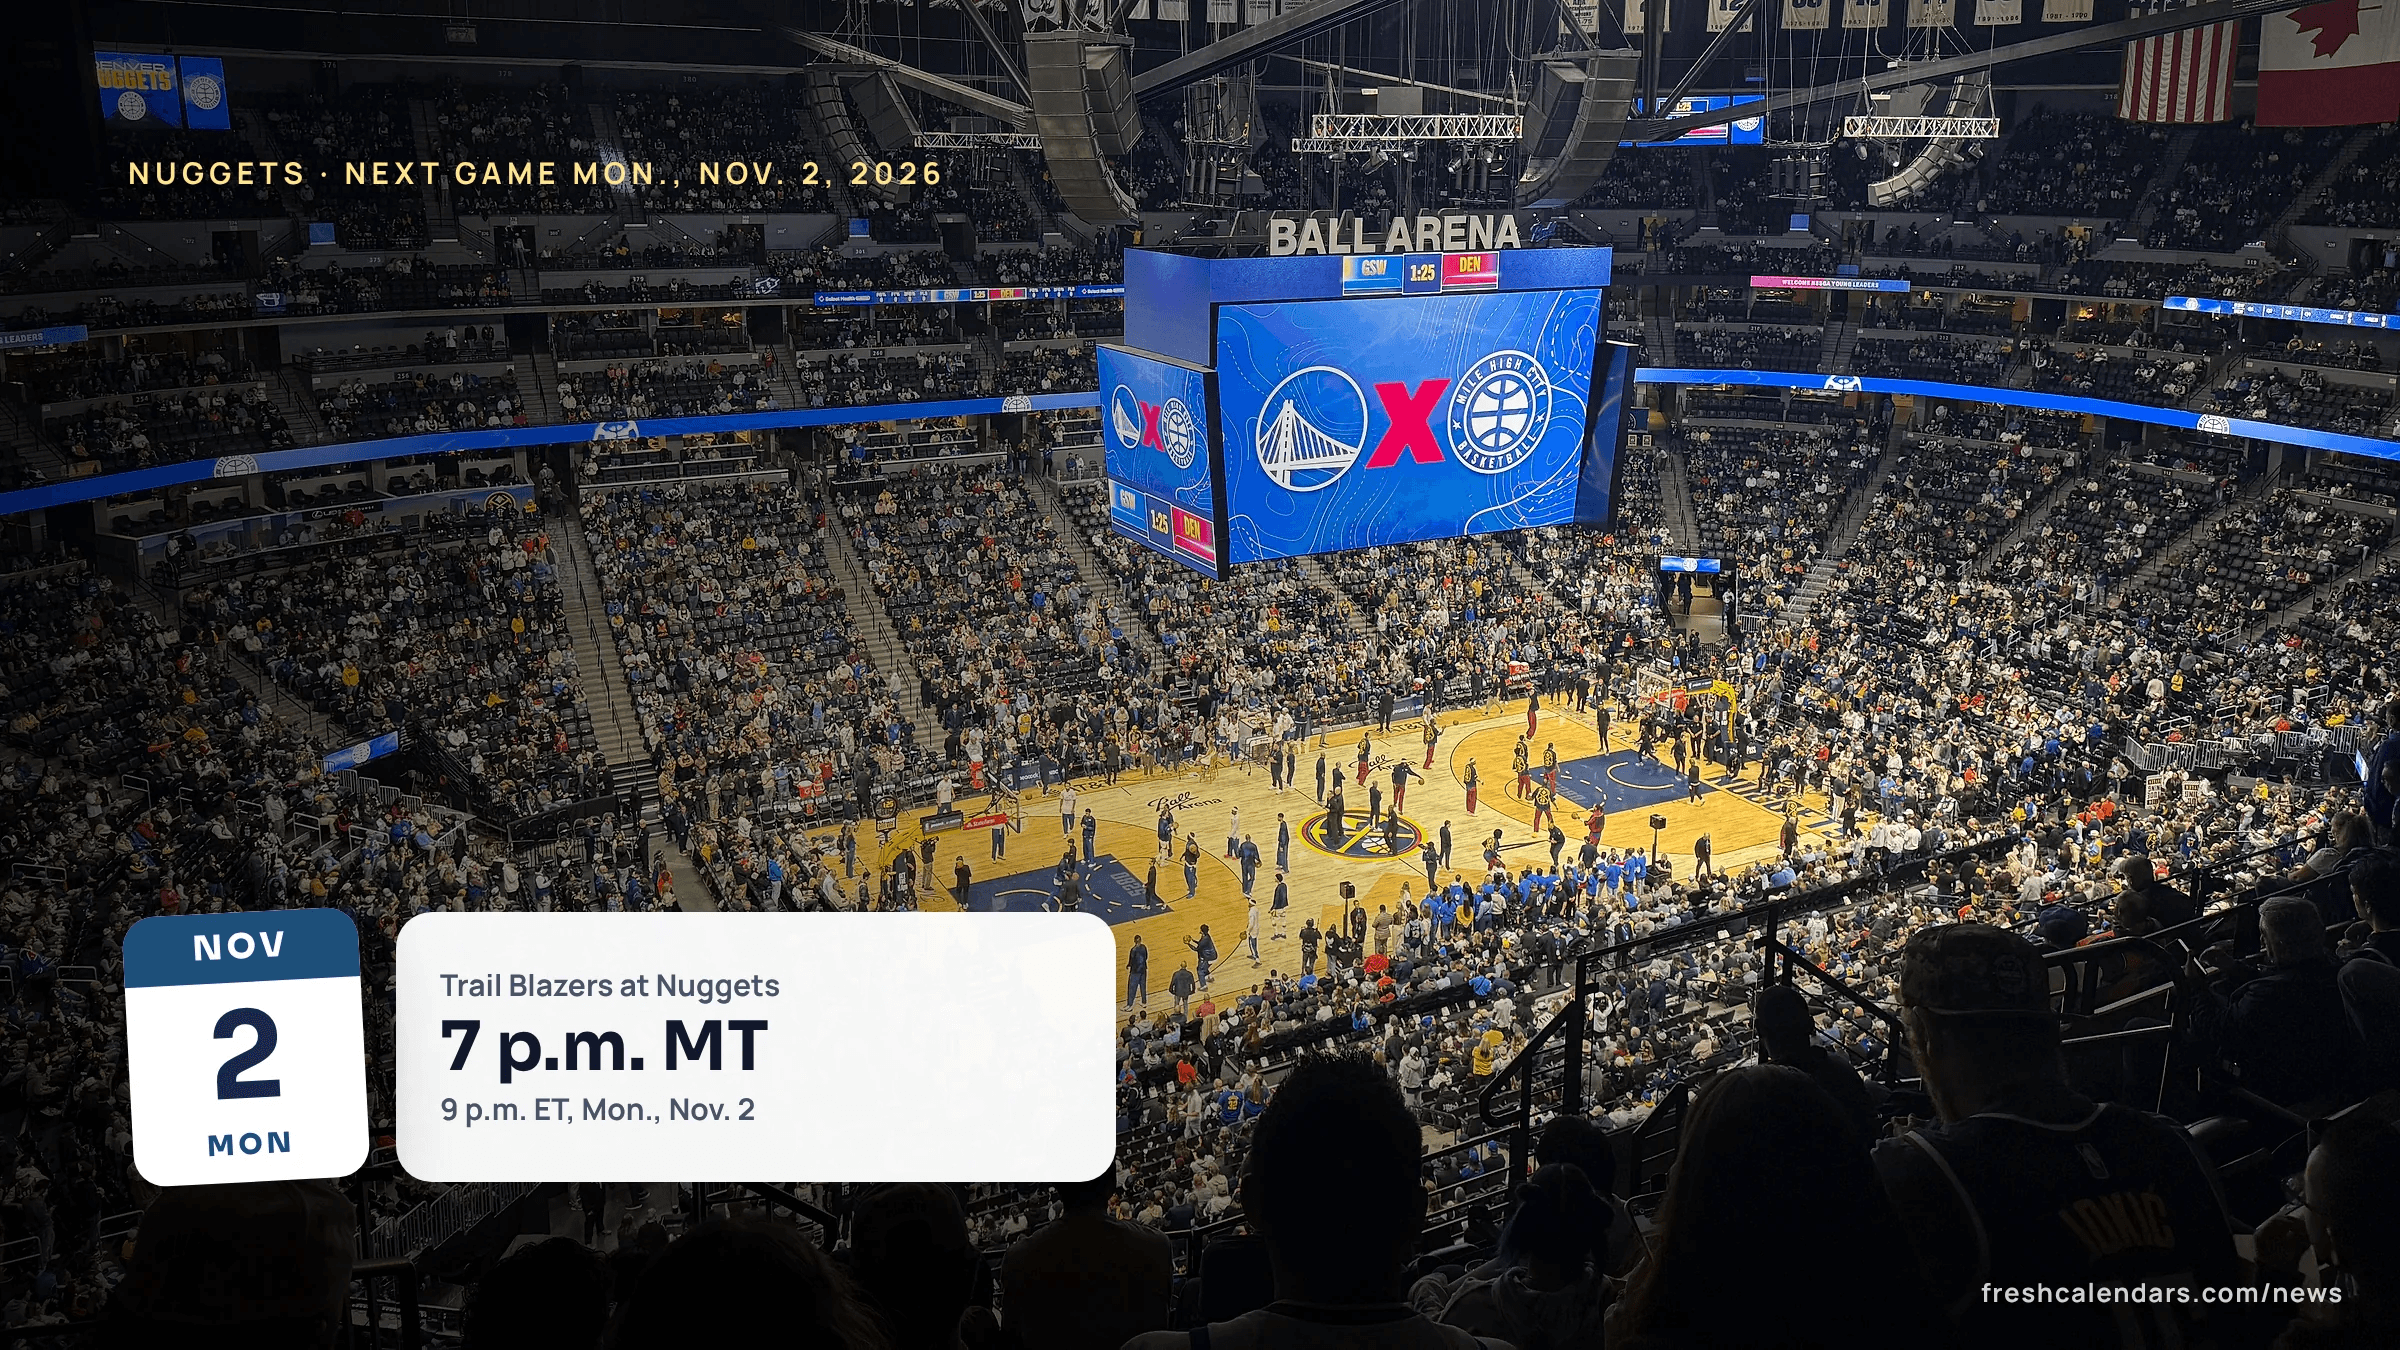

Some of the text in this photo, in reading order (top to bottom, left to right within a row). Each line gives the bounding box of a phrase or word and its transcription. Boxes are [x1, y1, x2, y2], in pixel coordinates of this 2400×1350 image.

[97, 69, 171, 91] UGGETS
[1270, 214, 1522, 256] BALL ARENA
[1362, 259, 1387, 276] GSW
[1411, 264, 1435, 282] 1:25
[1459, 256, 1481, 273] DEN
[4, 333, 43, 344] LEADERS
[1456, 357, 1547, 405] MILE HIGH CITY
[1365, 378, 1451, 470] X
[1457, 434, 1537, 469] BASKETBALL
[1120, 489, 1136, 510] GSW
[1151, 509, 1169, 535] 1:25
[1183, 515, 1201, 541] DEN
[1148, 791, 1199, 812] Ball
[1173, 797, 1223, 811] Arena
